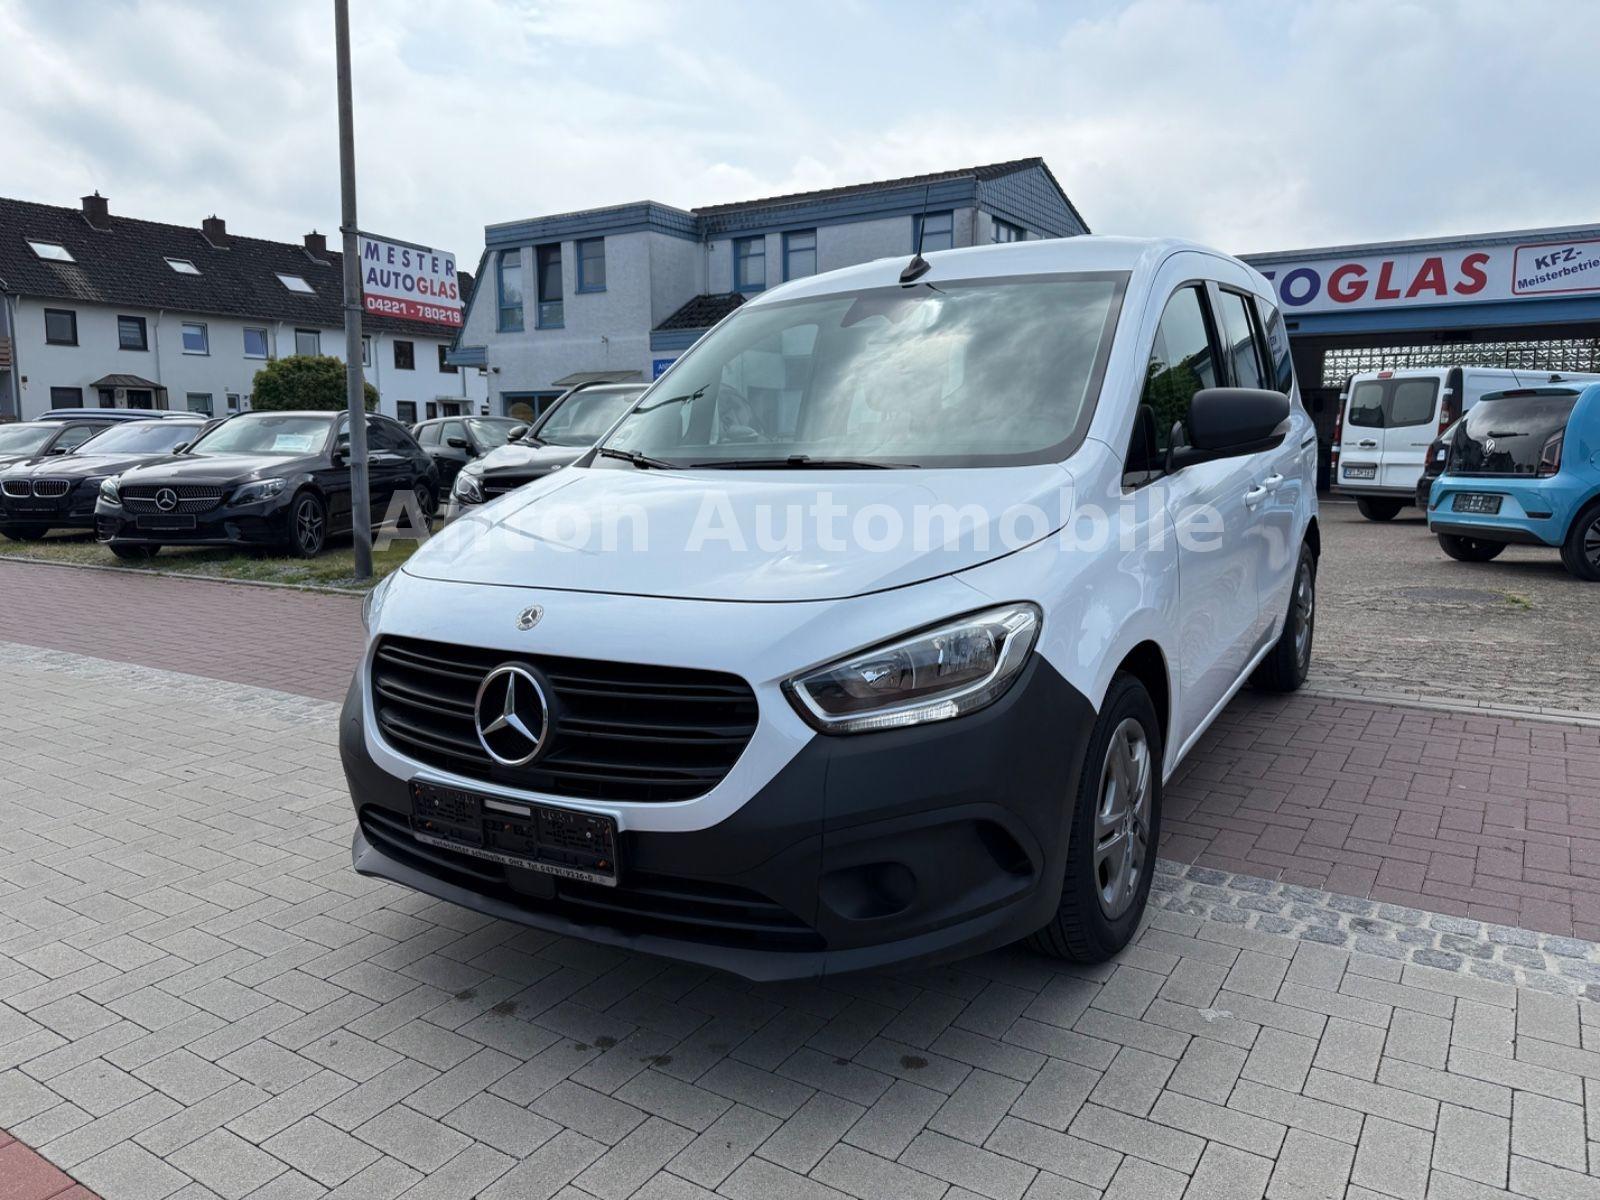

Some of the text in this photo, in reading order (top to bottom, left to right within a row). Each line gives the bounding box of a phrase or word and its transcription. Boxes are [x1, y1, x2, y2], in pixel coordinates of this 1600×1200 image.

[364, 241, 455, 278] MESTER
[1517, 256, 1600, 289] Meisterbetrie
[1535, 247, 1582, 270] KFZ-
[366, 266, 457, 300] AUTOGLAS
